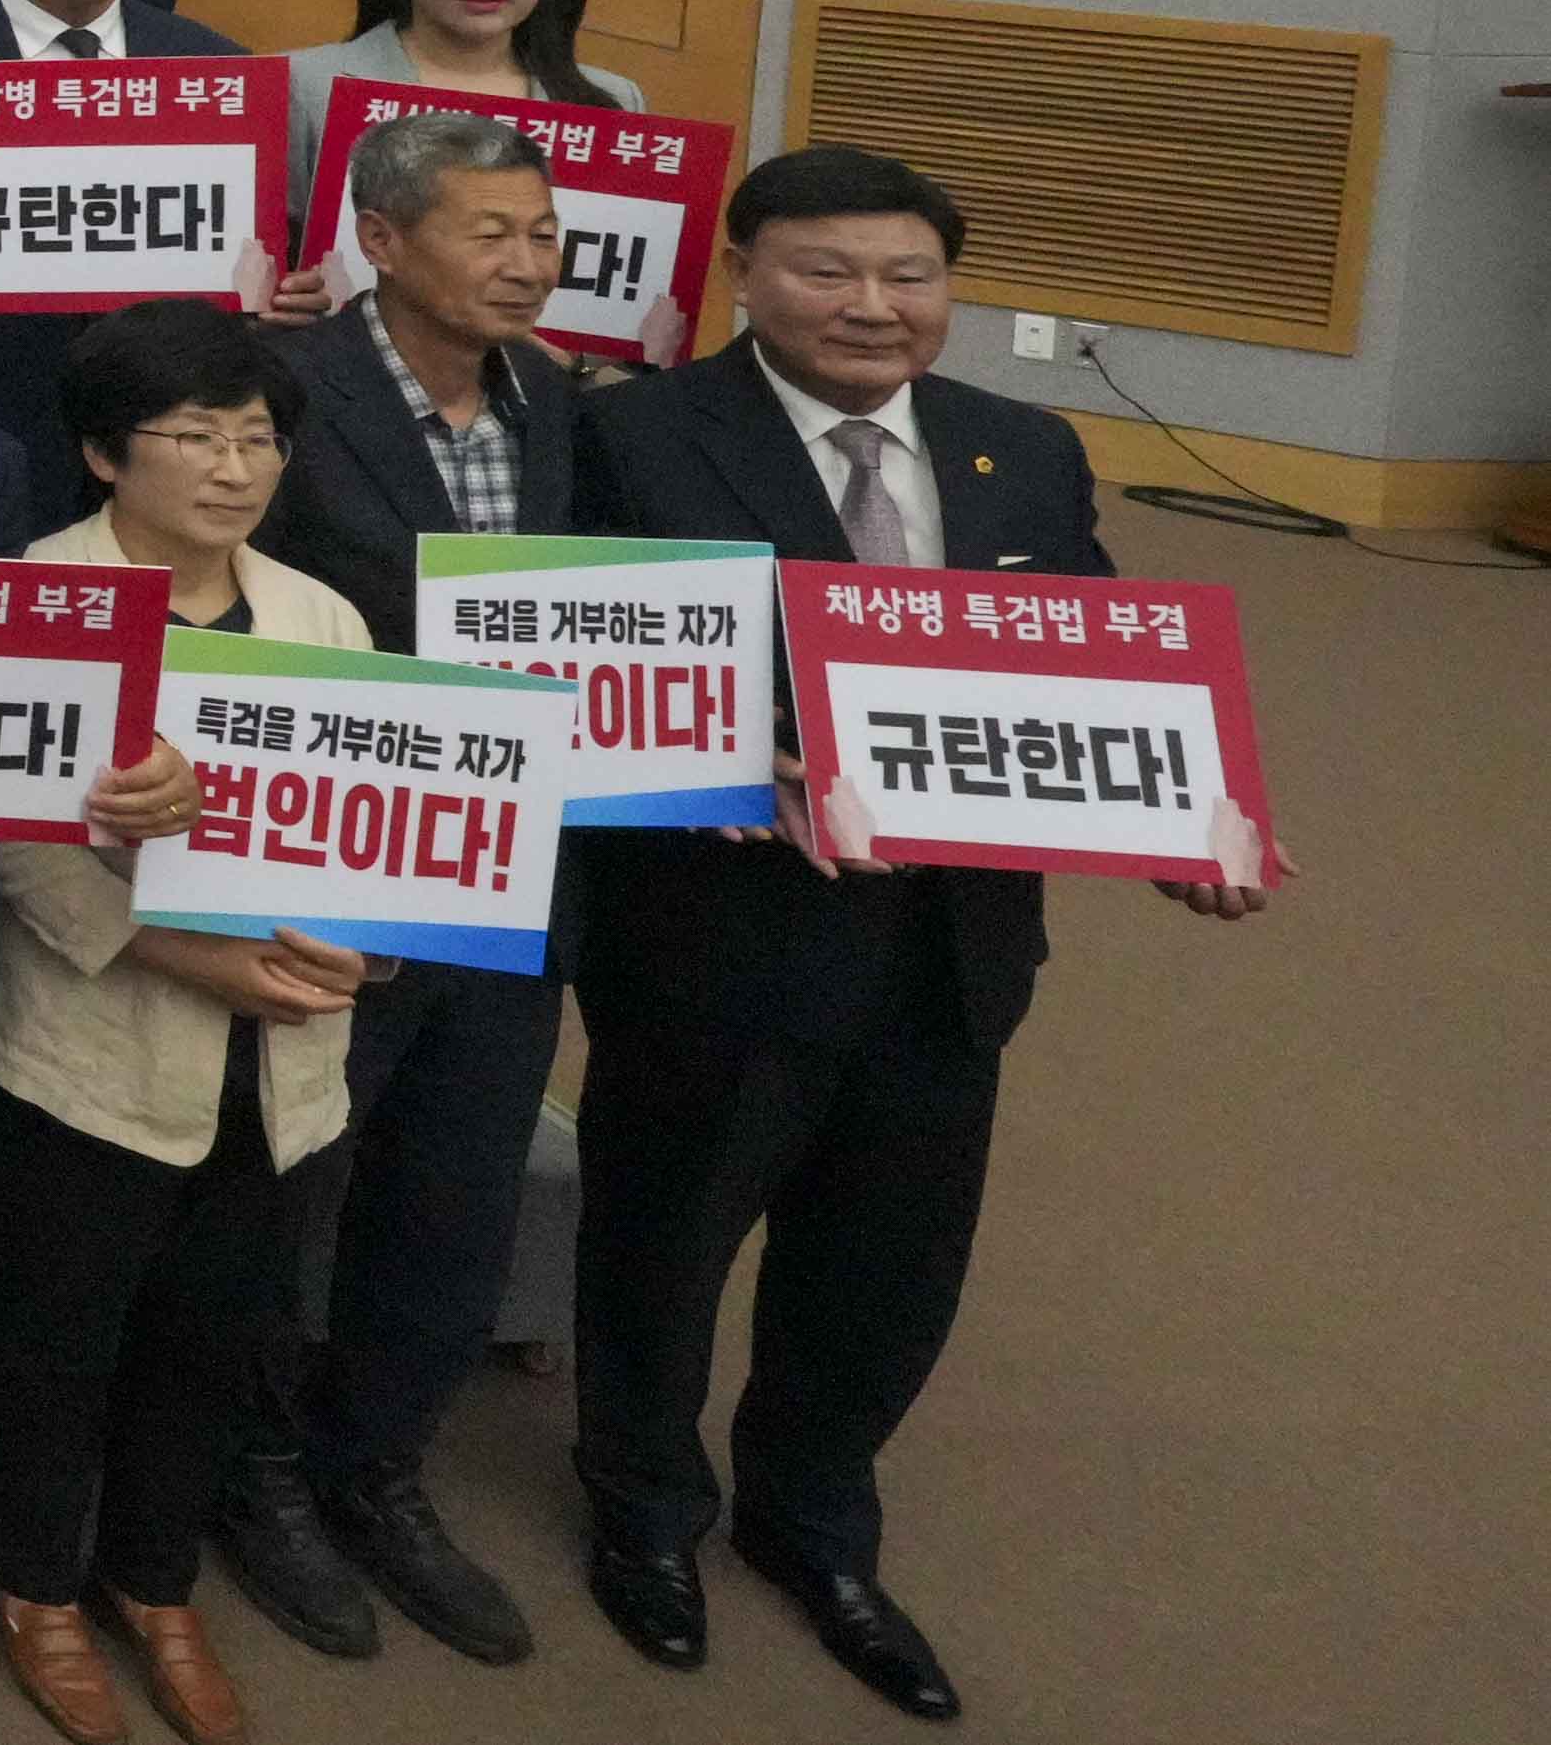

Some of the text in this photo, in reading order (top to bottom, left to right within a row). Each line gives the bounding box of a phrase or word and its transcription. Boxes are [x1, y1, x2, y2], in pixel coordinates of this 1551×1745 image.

[52, 76, 158, 118] 특검법
[174, 75, 245, 116] 부결
[29, 584, 116, 630] 부결
[454, 598, 737, 648] 특검을 거부하는 자가
[825, 584, 1189, 650] 채상병 특검법 부결
[196, 696, 526, 783] 특검을 거부하는 자가
[867, 710, 1192, 811] 규탄한다!
[189, 761, 517, 892] 범인이다!
